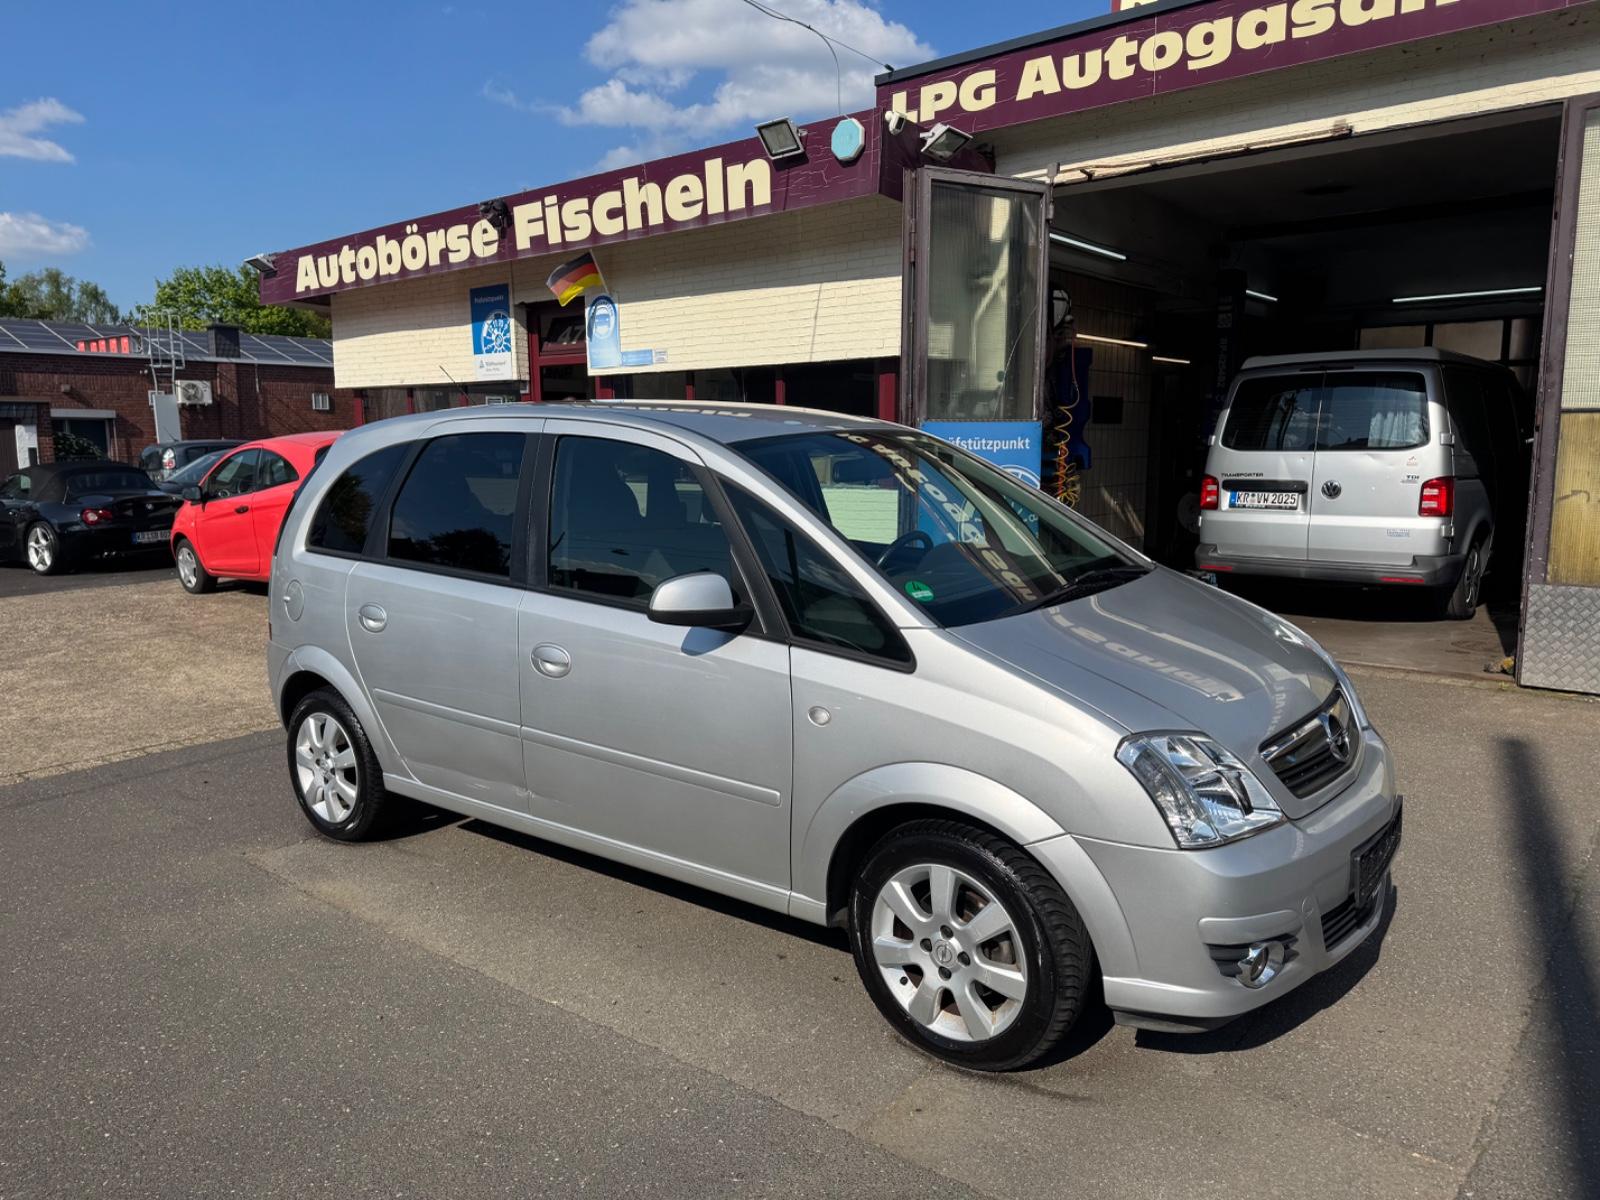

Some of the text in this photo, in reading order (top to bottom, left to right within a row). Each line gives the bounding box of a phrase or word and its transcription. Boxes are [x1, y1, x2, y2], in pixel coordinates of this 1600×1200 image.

[892, 0, 1460, 123] LPG Autogasa
[295, 157, 772, 293] Autobörse Fischeln
[948, 436, 1031, 453] üfstützpunkt
[1236, 491, 1297, 505] KR VW 2025
